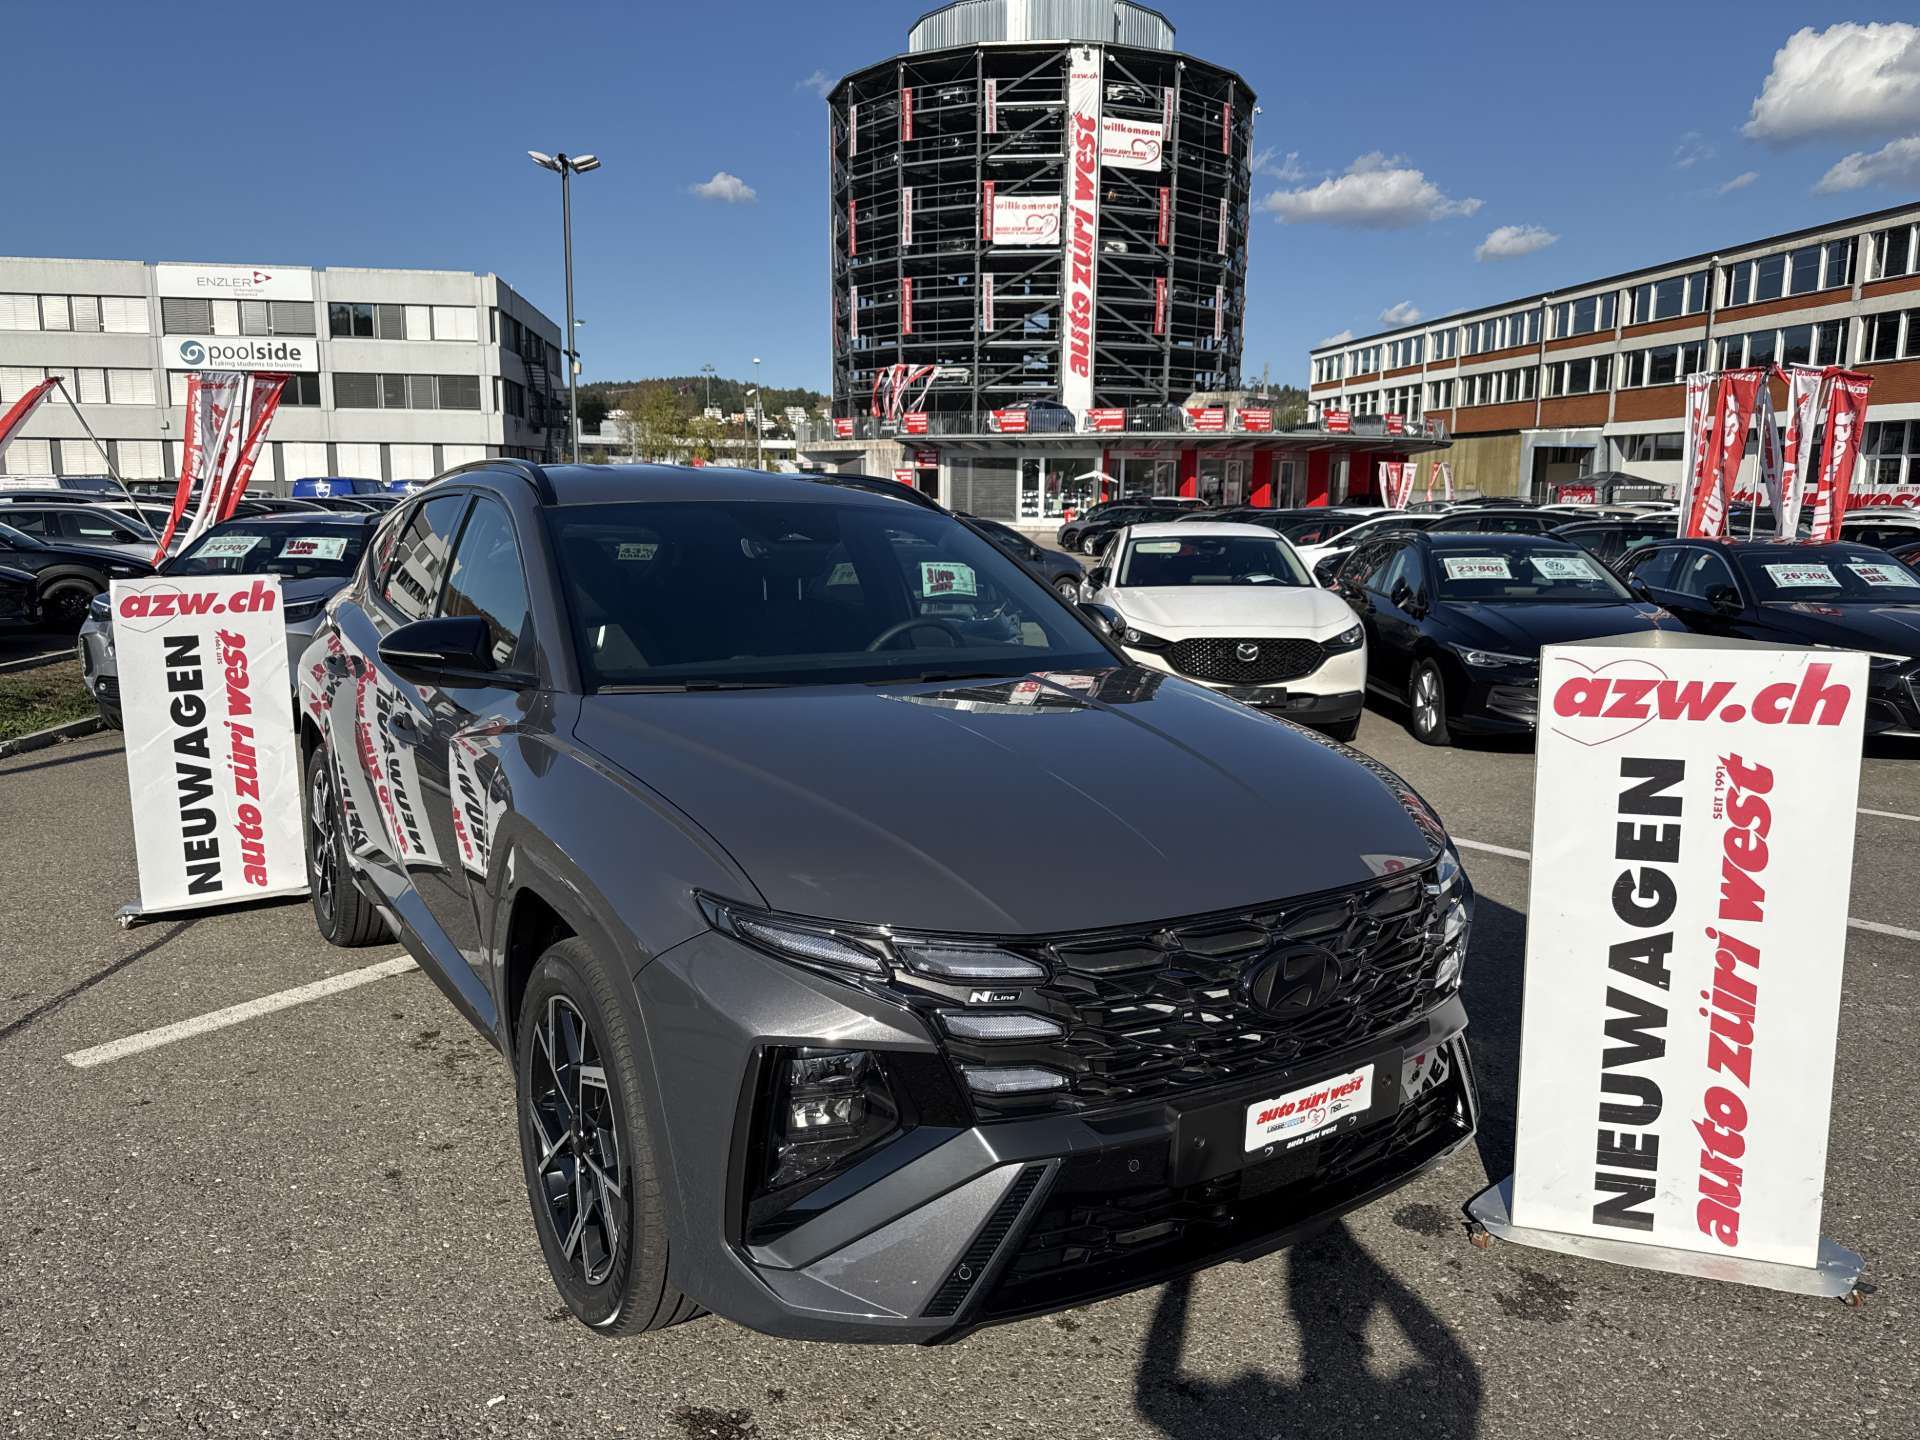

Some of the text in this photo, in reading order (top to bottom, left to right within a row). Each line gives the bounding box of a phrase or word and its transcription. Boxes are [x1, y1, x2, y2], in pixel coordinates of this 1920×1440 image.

[1103, 123, 1161, 137] willkommen
[995, 201, 1059, 210] willkommen
[1066, 111, 1096, 378] auto züri west
[196, 276, 252, 287] ENZLER
[208, 342, 302, 366] poolside
[214, 360, 236, 368] taking
[275, 361, 303, 369] business
[1456, 565, 1504, 573] 23'800
[1781, 572, 1831, 580] 26'300
[119, 580, 276, 618] azw.ch
[1552, 663, 1851, 727] azw.ch
[163, 635, 223, 896] NEUWAGEN
[216, 629, 268, 888] auto züri west
[1713, 765, 1726, 820] SEIT 1991
[969, 991, 992, 1002] N
[1592, 757, 1686, 1232] NEUWAGEN
[1691, 752, 1775, 1248] auto züri west
[1257, 1075, 1364, 1125] auto züri west
[1286, 1124, 1338, 1149] auto züri west
